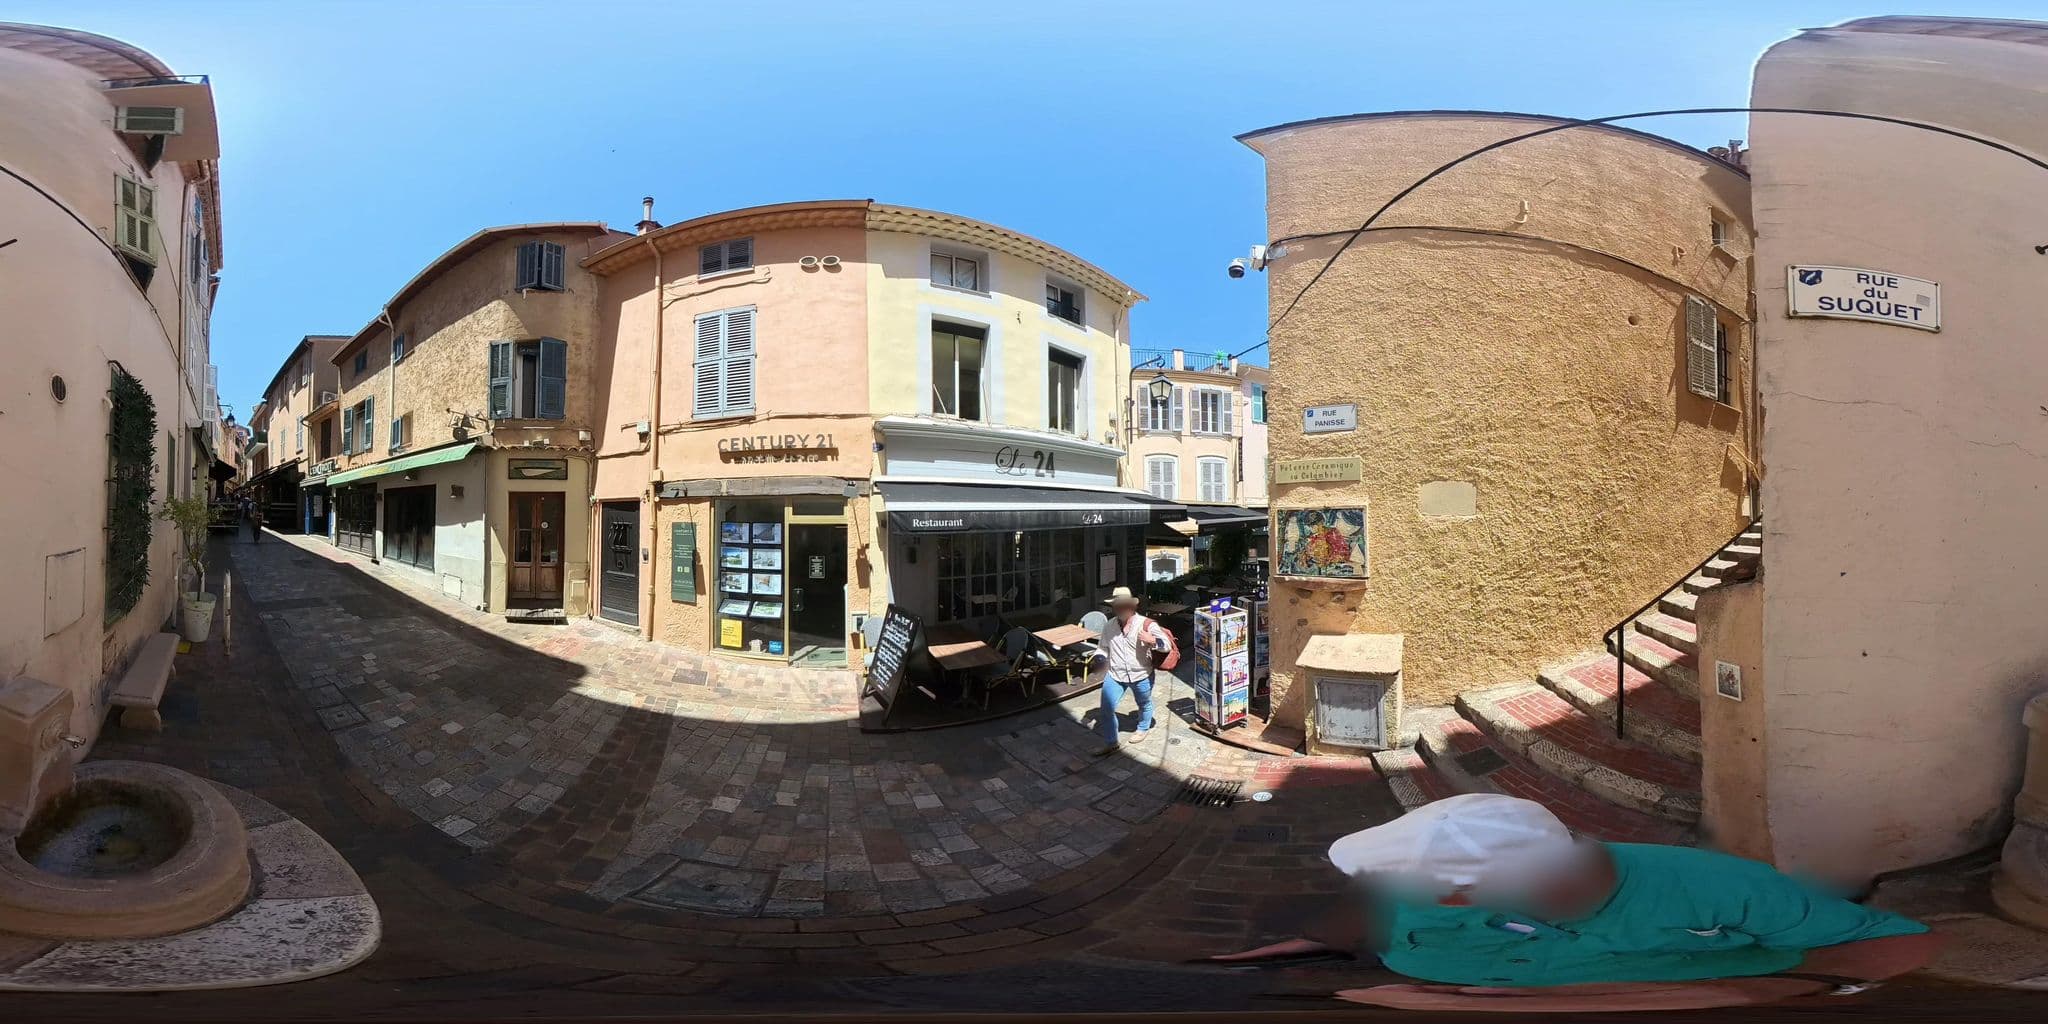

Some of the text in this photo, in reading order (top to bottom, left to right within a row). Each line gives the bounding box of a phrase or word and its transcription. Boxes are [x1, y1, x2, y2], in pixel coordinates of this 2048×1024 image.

[1857, 273, 1898, 288] RUE
[1863, 287, 1888, 300] du
[1818, 297, 1922, 321] SUQUET
[1315, 419, 1346, 427] PANISSE
[717, 433, 834, 453] CENTURY 21
[1033, 450, 1056, 478] 24
[912, 517, 964, 528] Restaurant
[1093, 514, 1103, 524] 24
